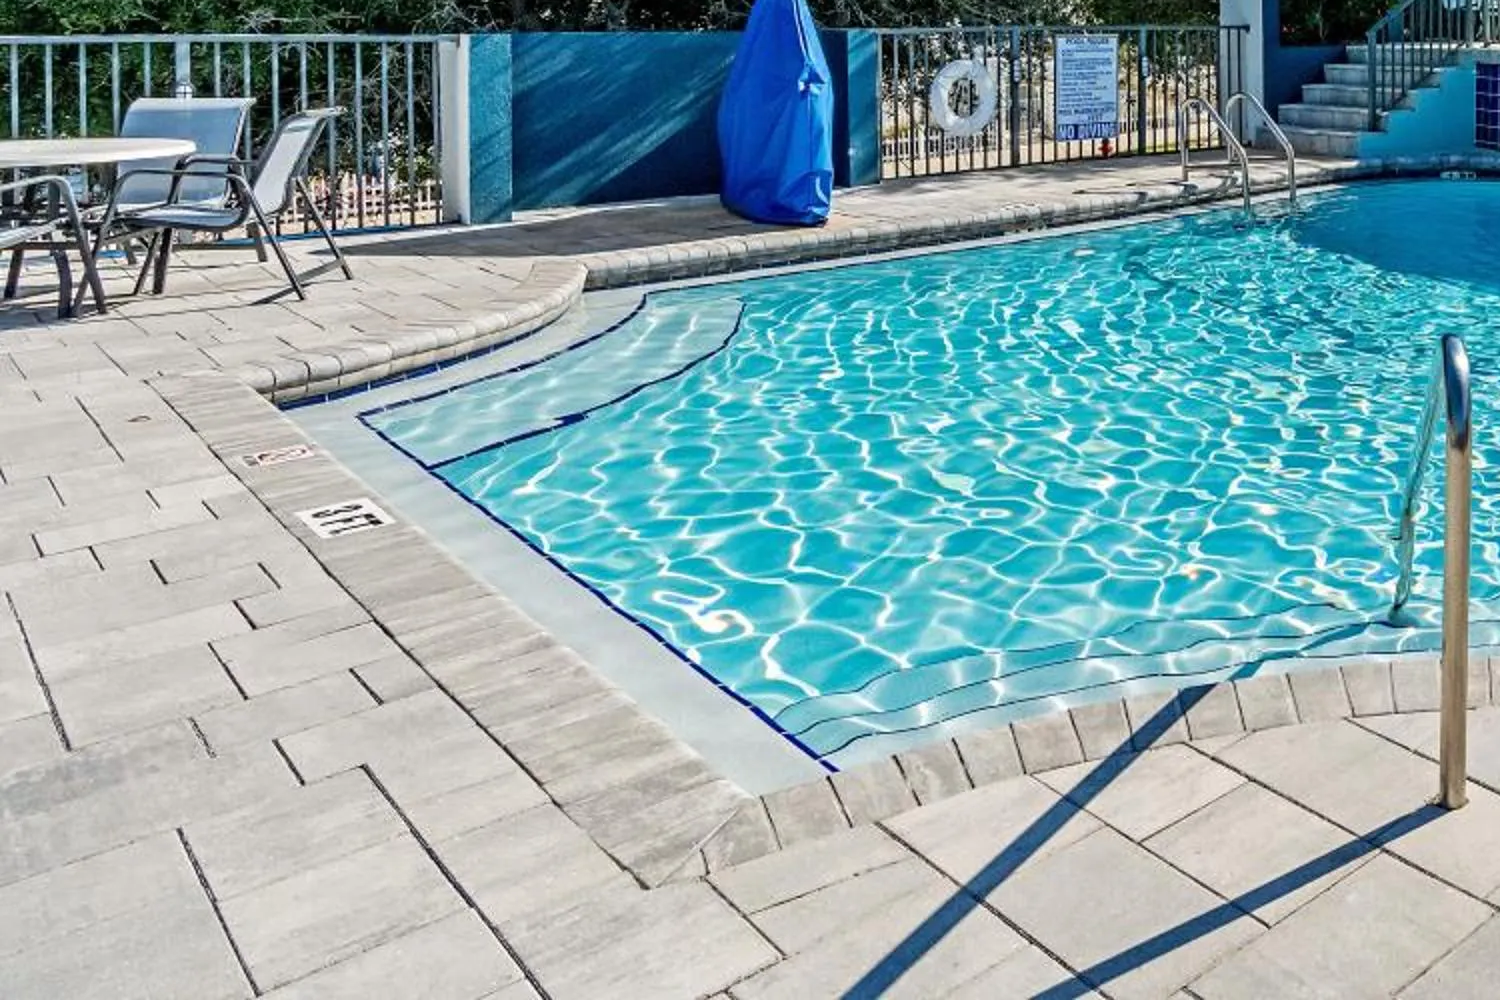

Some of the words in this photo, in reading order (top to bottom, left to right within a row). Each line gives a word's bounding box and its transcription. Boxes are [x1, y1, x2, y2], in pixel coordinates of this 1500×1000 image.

[1060, 124, 1075, 139] NO
[311, 503, 363, 519] 3
[319, 512, 384, 535] FT
